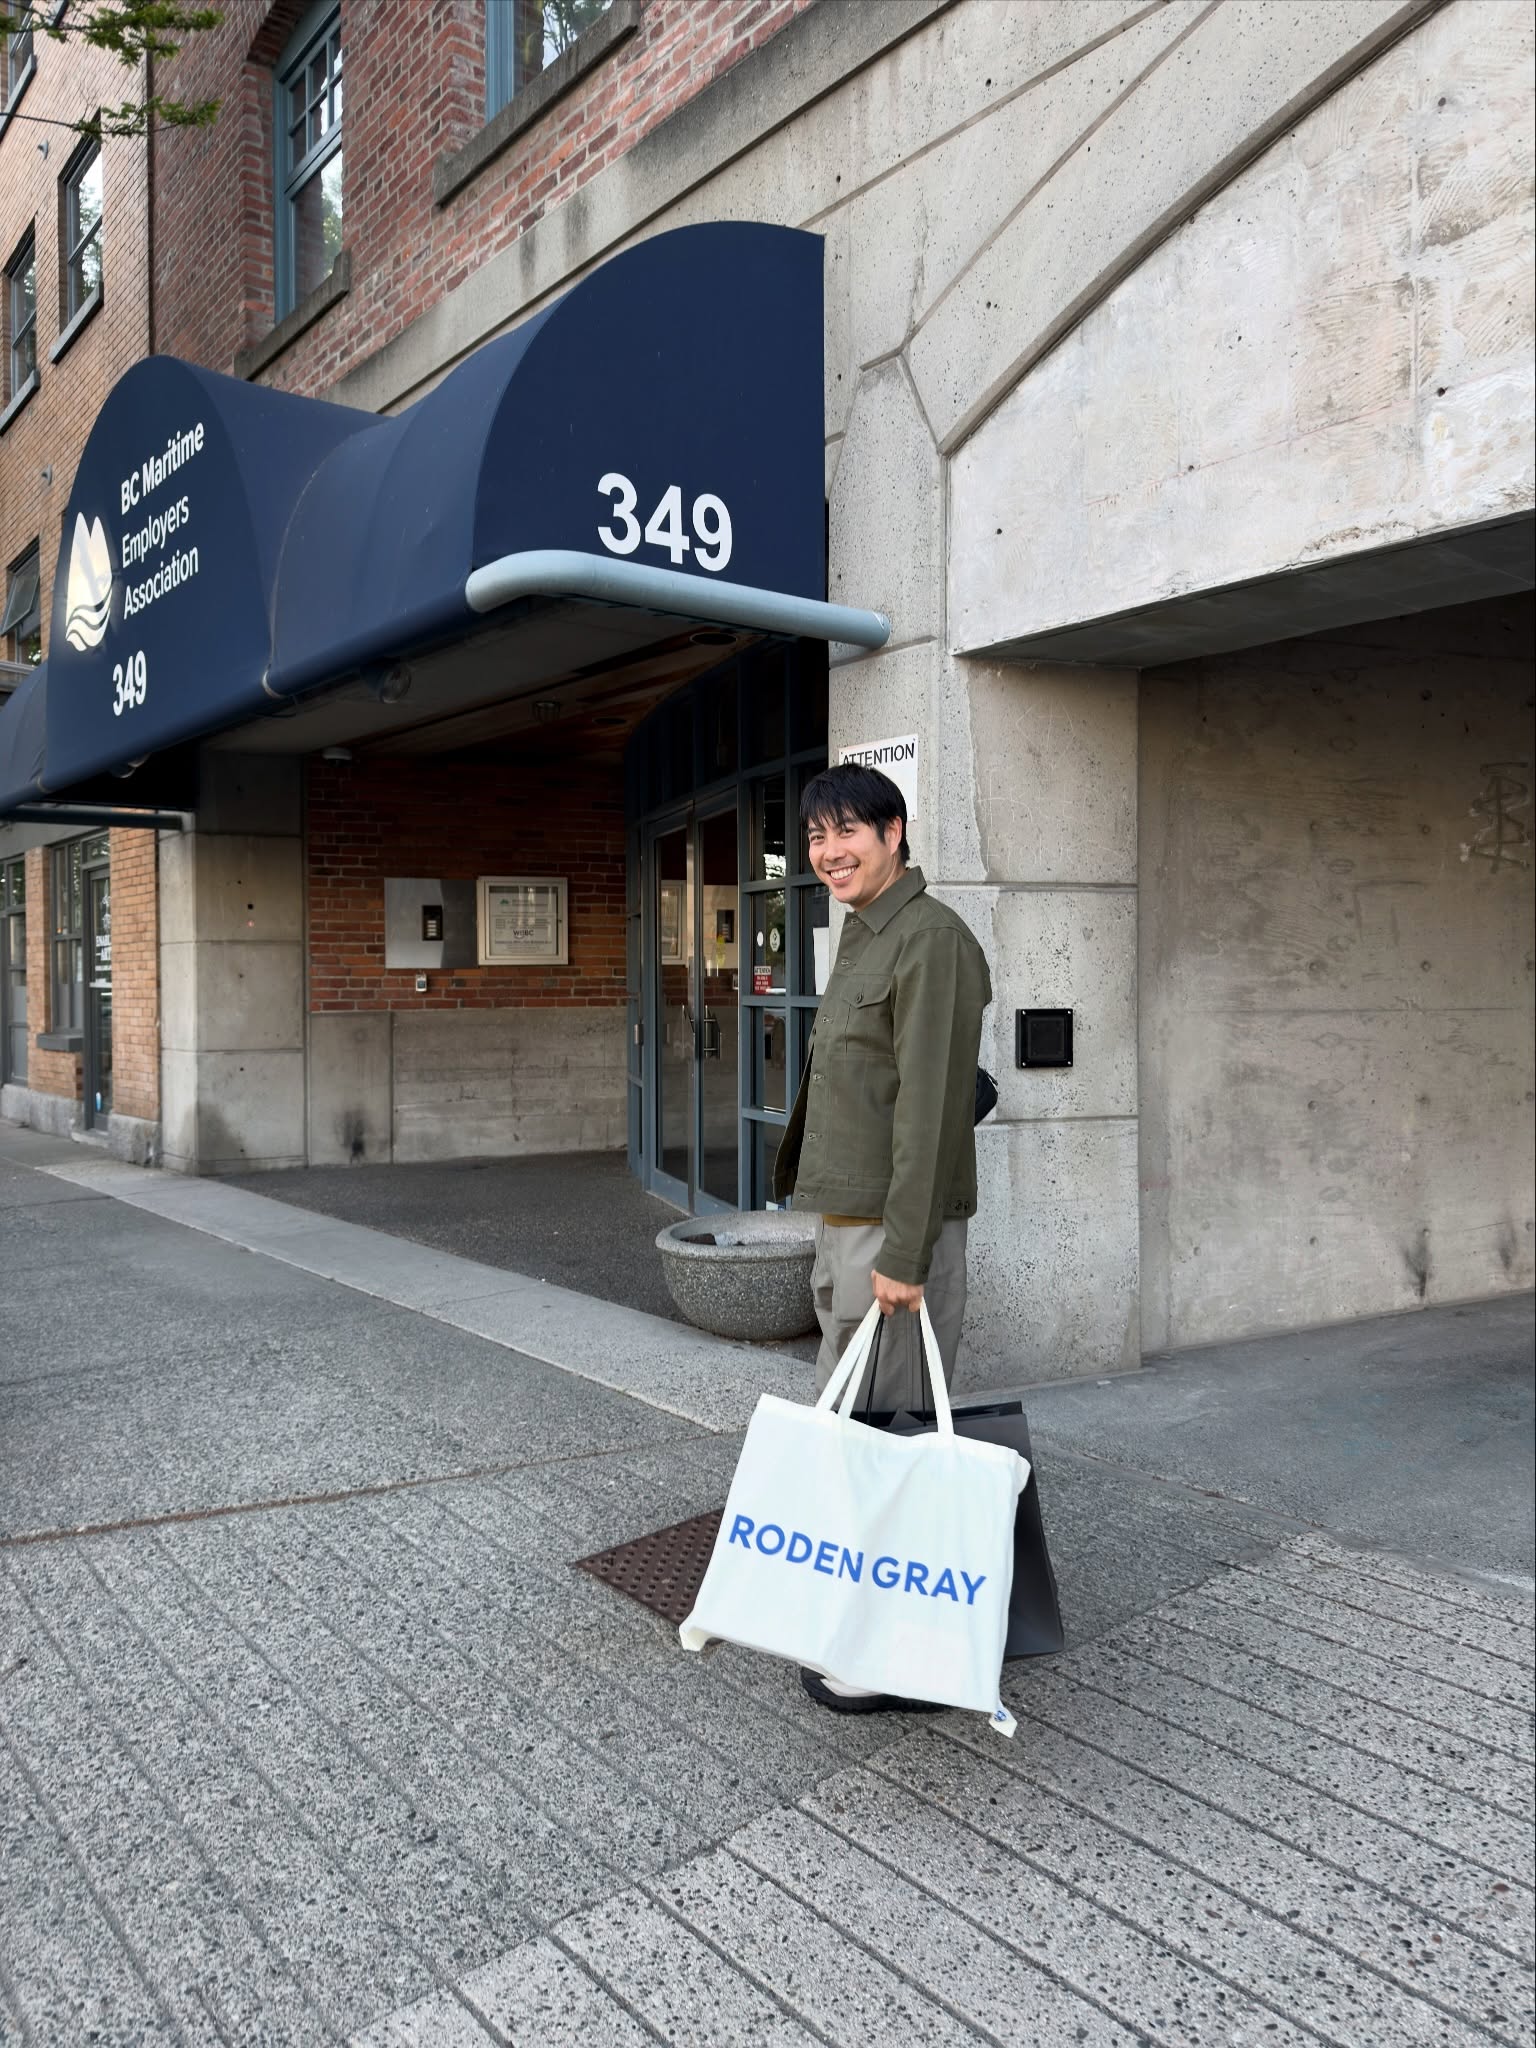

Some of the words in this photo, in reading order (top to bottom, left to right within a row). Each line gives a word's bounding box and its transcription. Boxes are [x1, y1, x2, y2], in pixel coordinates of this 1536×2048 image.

[121, 471, 140, 516] BC
[142, 422, 204, 497] Maritime
[122, 495, 190, 569] Employers
[597, 472, 733, 572] 349
[123, 546, 199, 621] Association
[112, 650, 147, 717] 349
[843, 742, 915, 767] ATTENTION
[728, 1514, 865, 1584] RODEN
[872, 1556, 987, 1606] GRAY
